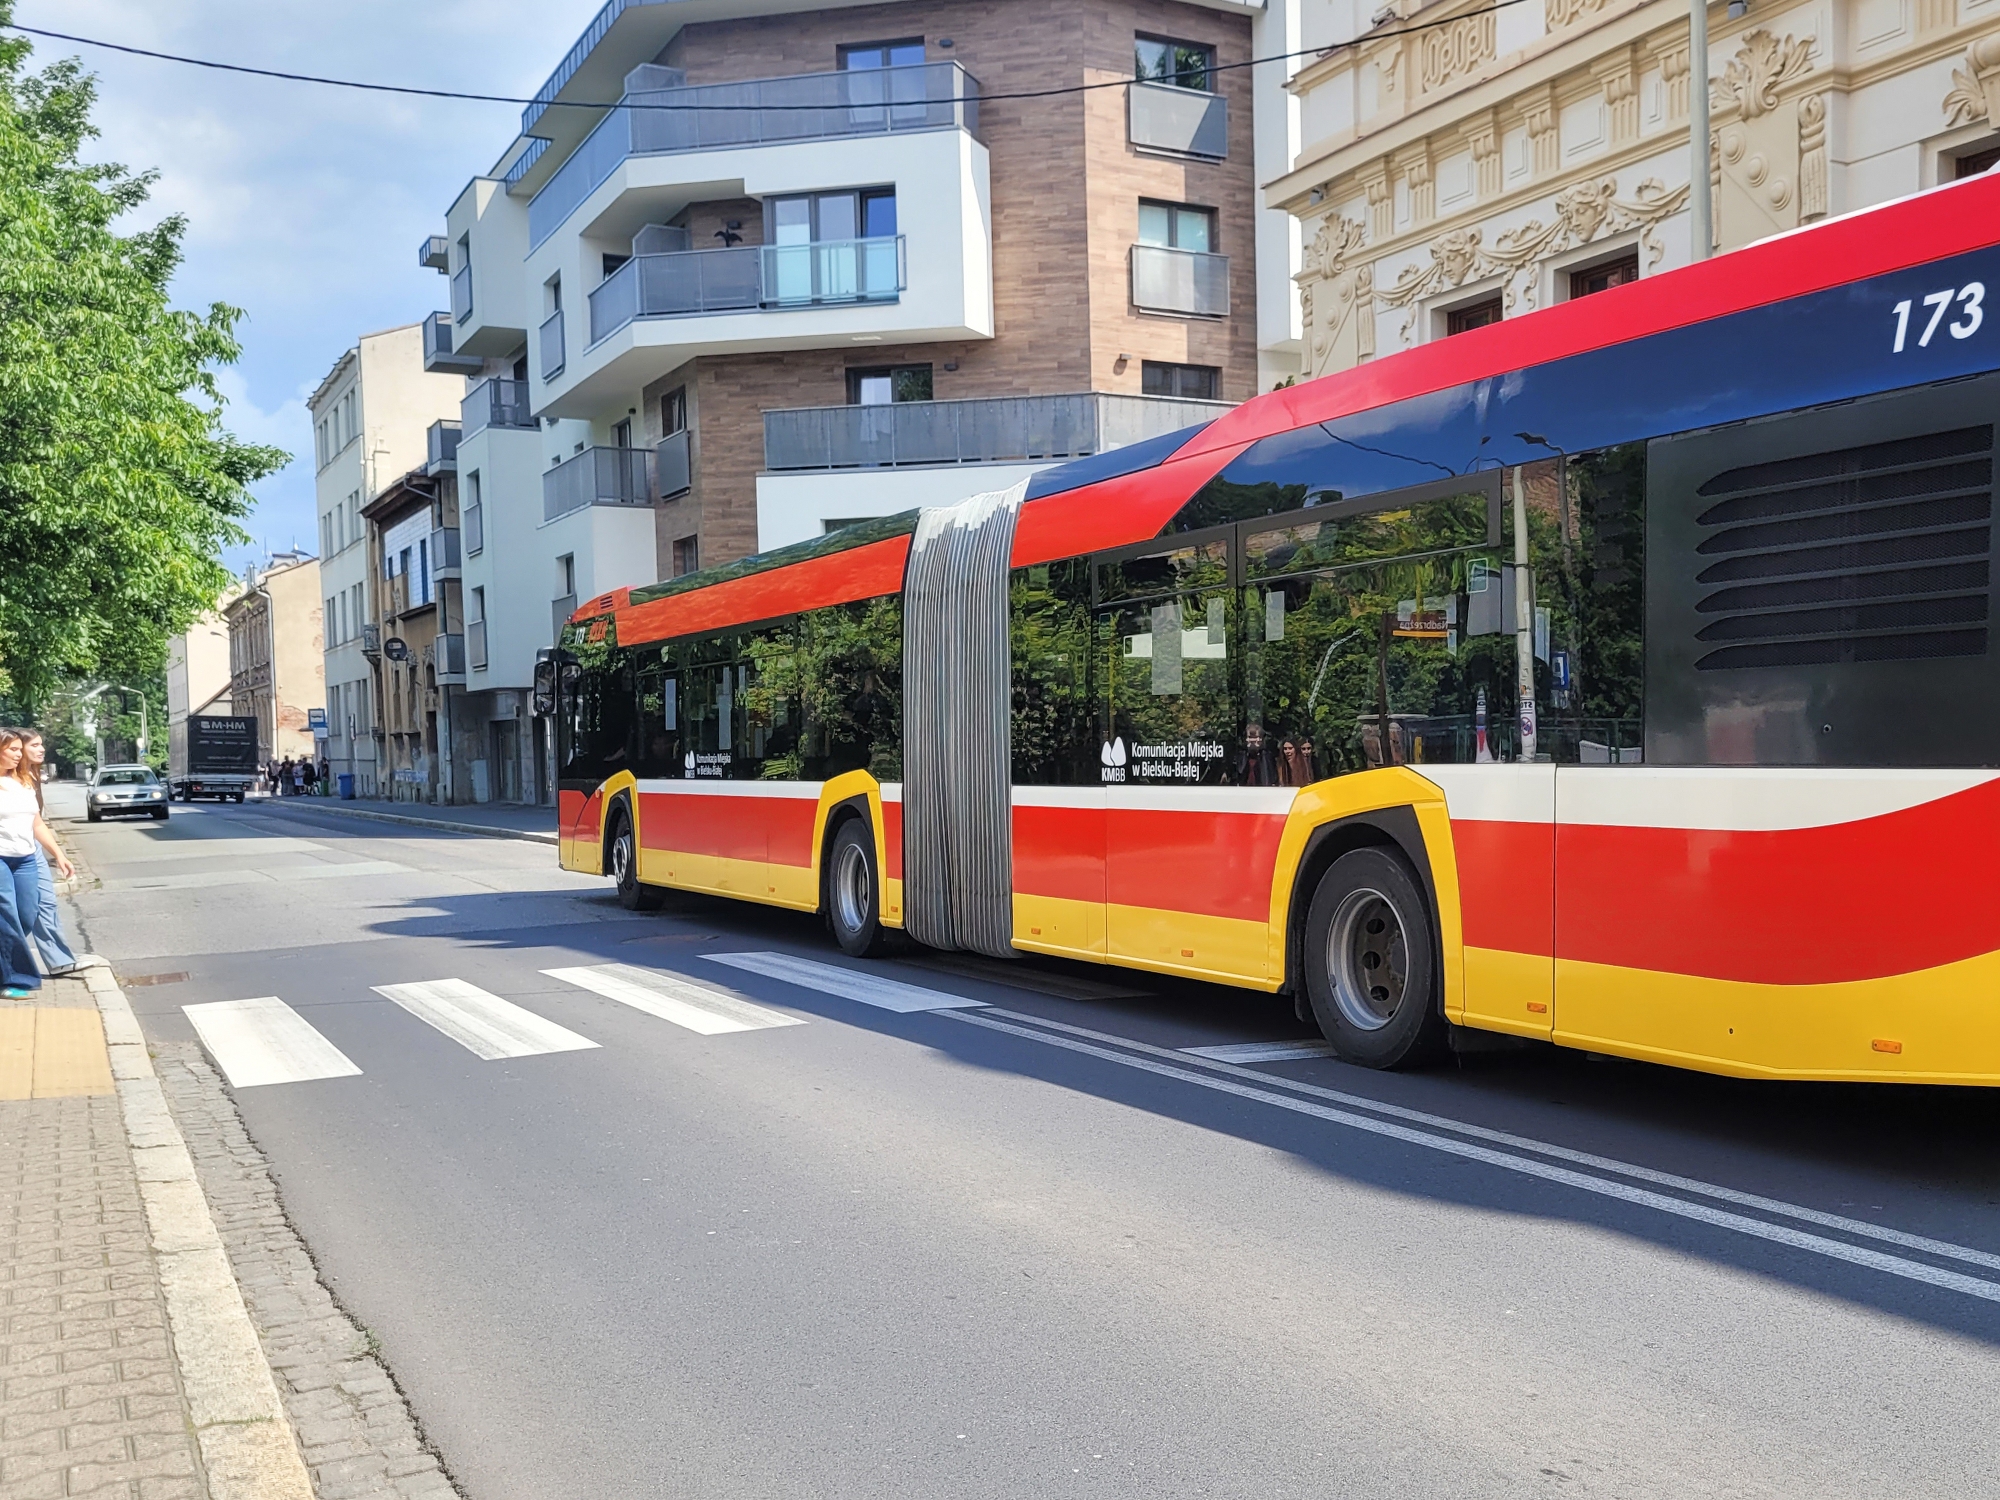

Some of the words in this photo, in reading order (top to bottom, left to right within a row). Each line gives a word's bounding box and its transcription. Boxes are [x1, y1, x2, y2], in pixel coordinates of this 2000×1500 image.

[1892, 281, 1986, 354] 173
[1131, 741, 1185, 761] Komunikacja
[1187, 740, 1224, 762] Miejska
[1101, 767, 1126, 782] KMBB
[1132, 764, 1140, 777] w
[1141, 760, 1200, 782] Bielsku-Białej
